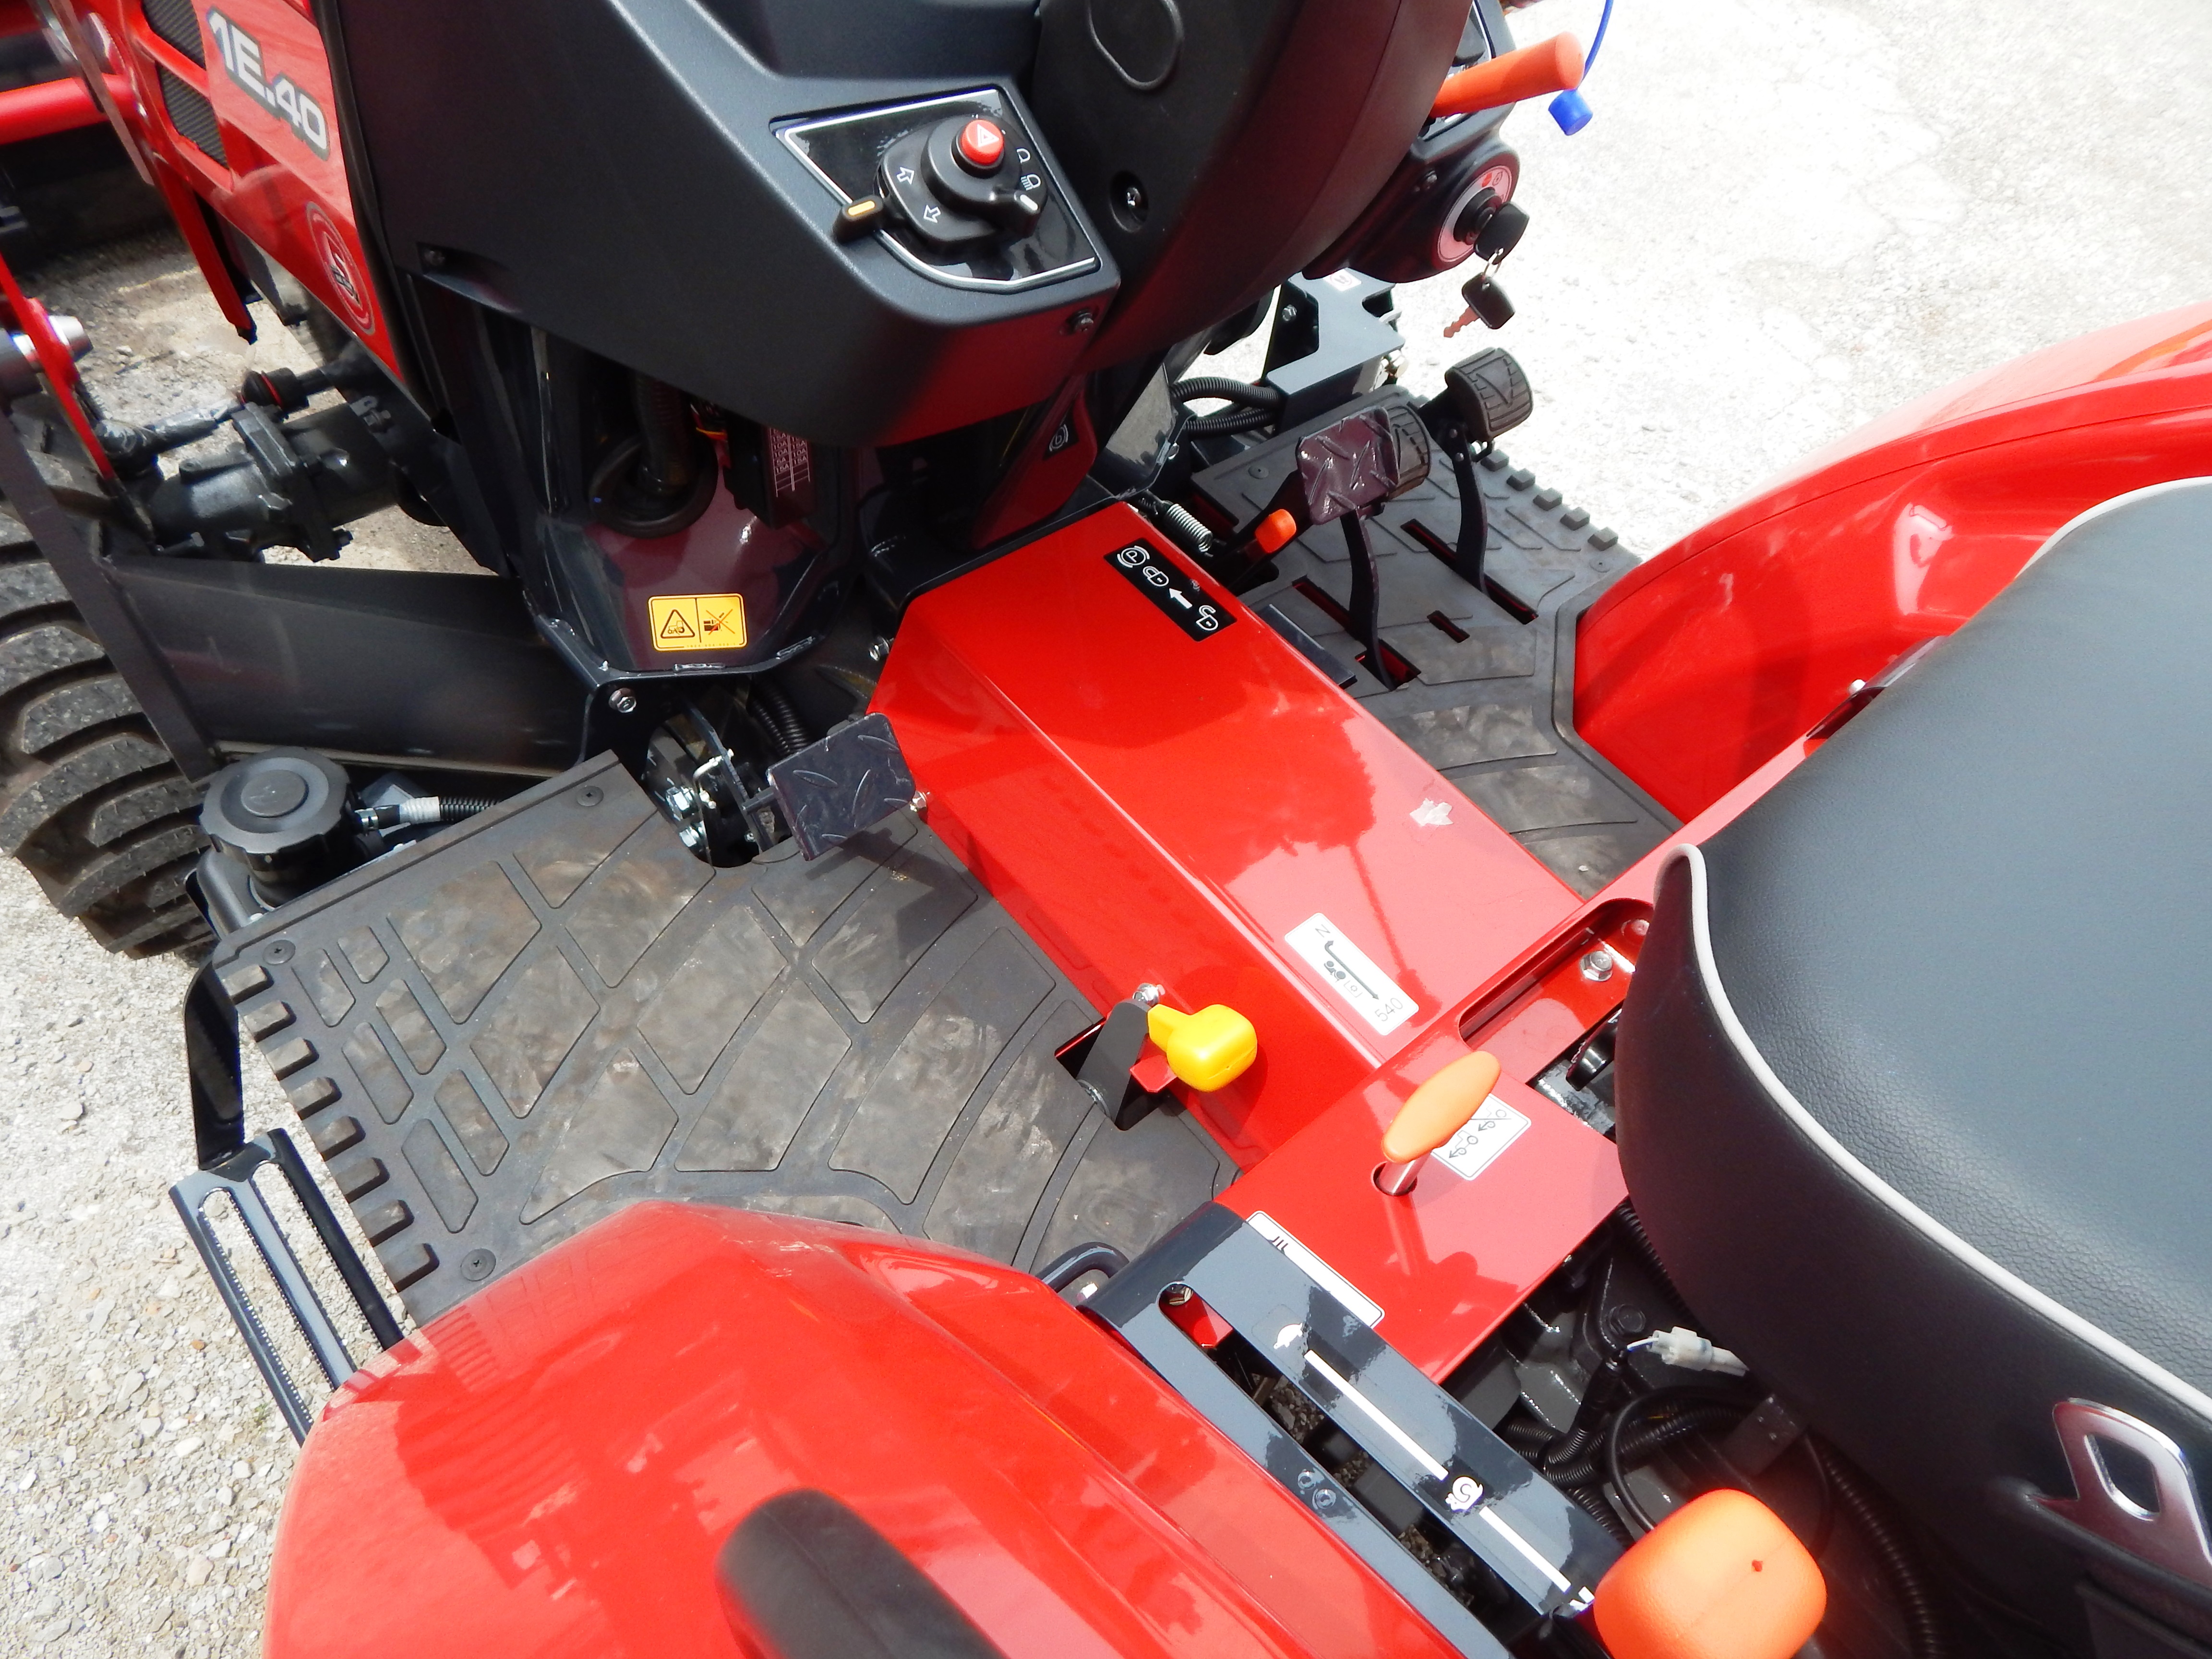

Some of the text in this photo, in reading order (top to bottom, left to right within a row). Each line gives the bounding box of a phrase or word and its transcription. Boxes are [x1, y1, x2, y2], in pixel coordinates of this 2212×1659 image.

[794, 448, 806, 457] 10A
[1315, 924, 1331, 938] N
[1374, 998, 1403, 1022] 540
